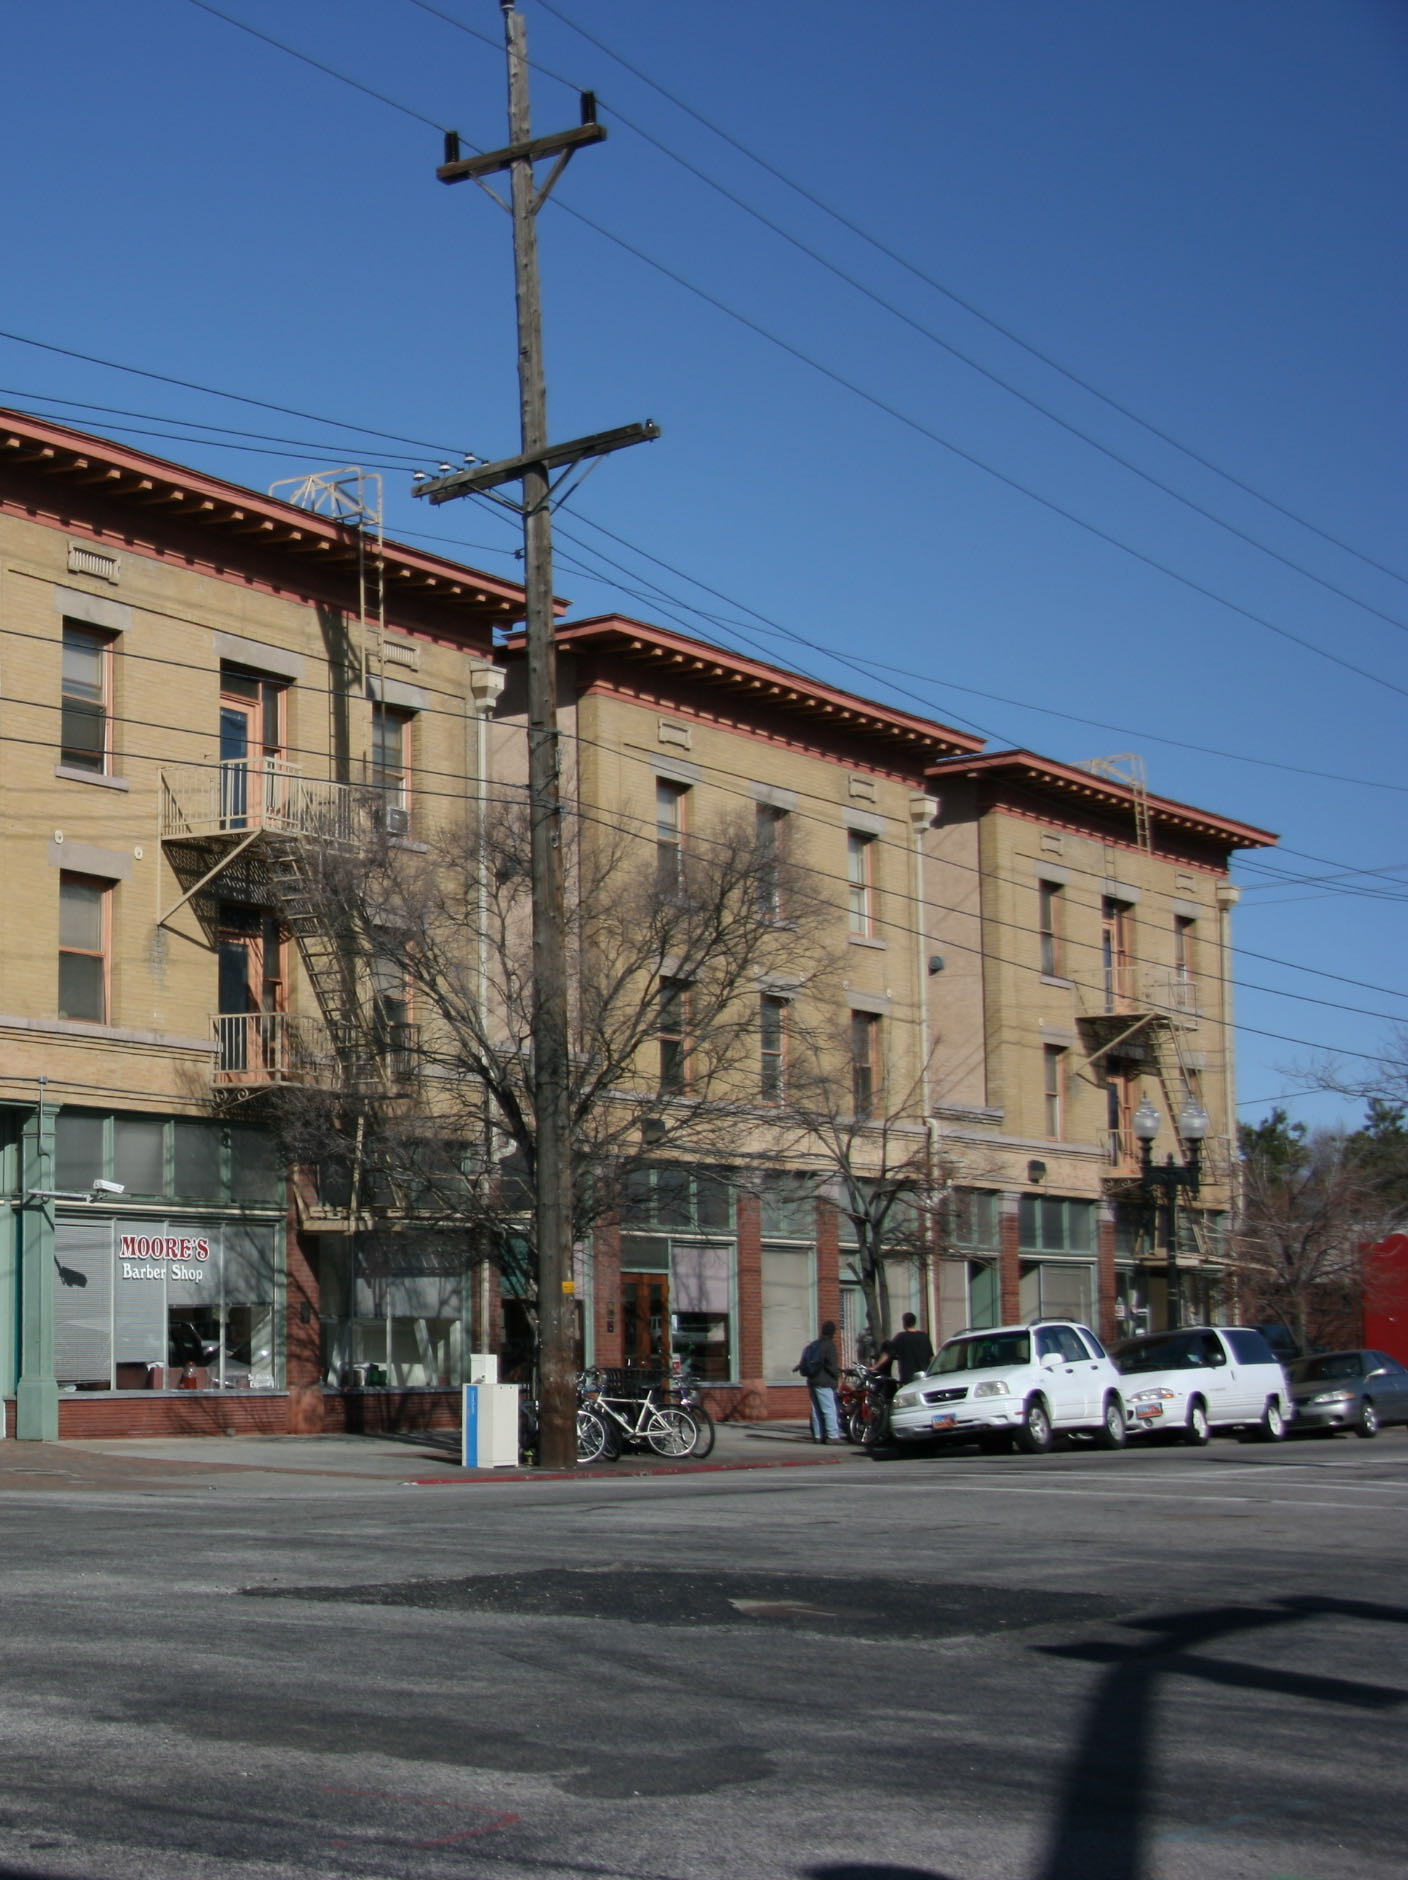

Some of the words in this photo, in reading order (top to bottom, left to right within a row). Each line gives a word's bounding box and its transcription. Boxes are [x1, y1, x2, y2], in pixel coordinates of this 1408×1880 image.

[119, 1235, 210, 1262] MOORE'S
[122, 1262, 167, 1279] Barber
[171, 1264, 203, 1283] Shop
